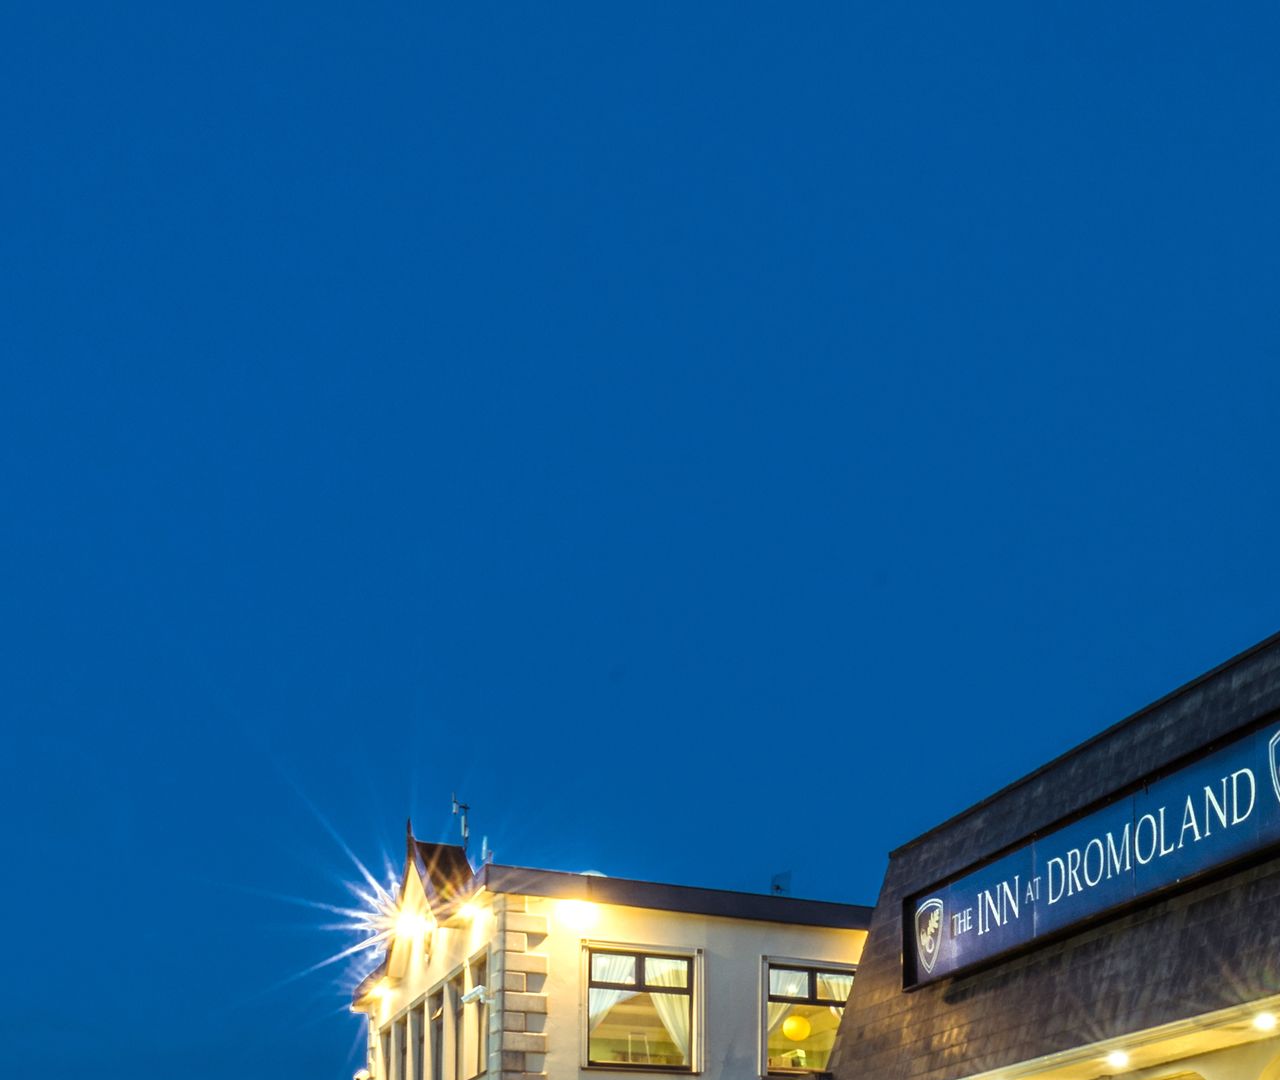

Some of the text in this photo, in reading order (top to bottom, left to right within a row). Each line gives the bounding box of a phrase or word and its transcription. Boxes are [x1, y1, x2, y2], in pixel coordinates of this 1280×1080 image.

[952, 767, 1256, 936] THE INN AT DROMOLAND
